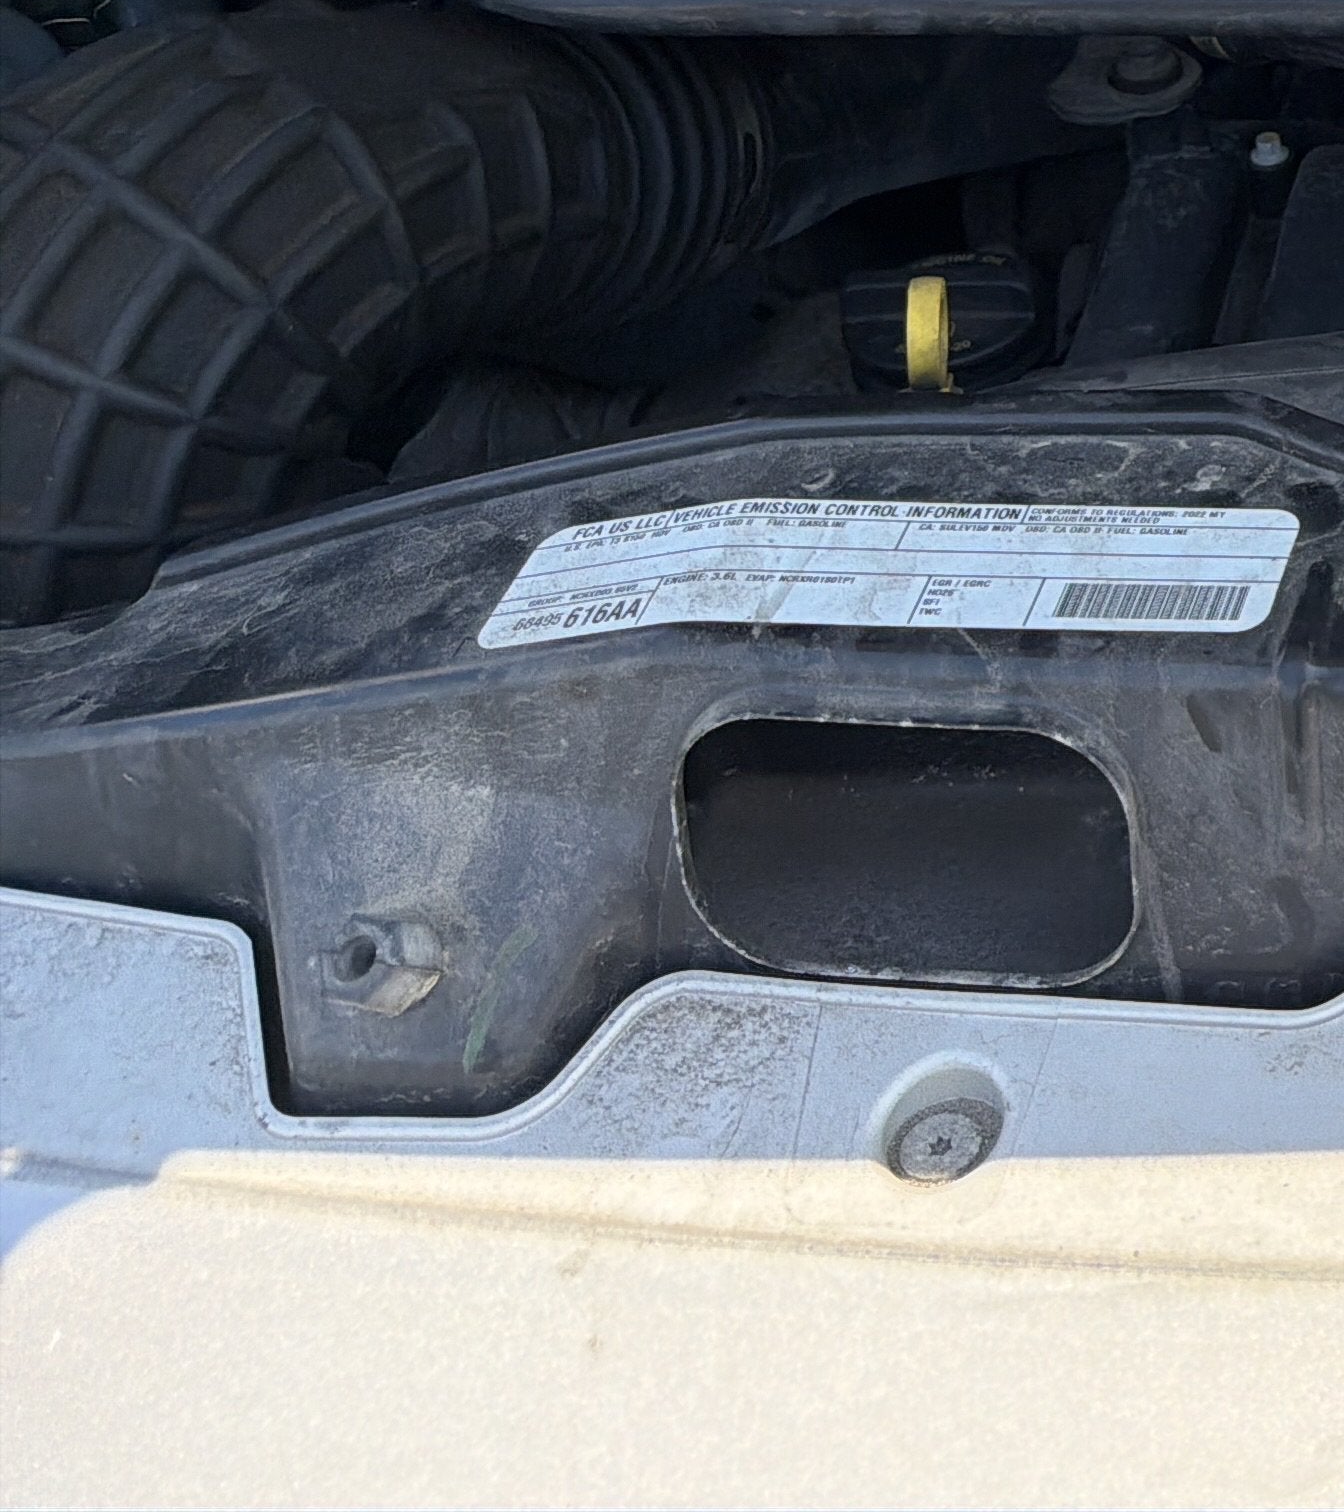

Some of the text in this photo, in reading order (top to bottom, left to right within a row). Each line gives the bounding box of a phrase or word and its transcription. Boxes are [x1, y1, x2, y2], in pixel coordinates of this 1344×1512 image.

[1028, 514, 1161, 525] NO ADJUSTMENTS NEEDED
[1030, 508, 1090, 517] CONFORMS
[1091, 508, 1105, 517] TO
[1182, 510, 1208, 520] 2022
[1209, 511, 1226, 520] MY
[573, 501, 1023, 541] FCA US LLC VEHICLE EMISSION CONTROL INFORMATION
[798, 519, 848, 529] GASOLINE
[1139, 527, 1190, 537] GASOLINE
[711, 571, 737, 582] 3.6L
[563, 598, 643, 629] 616AA
